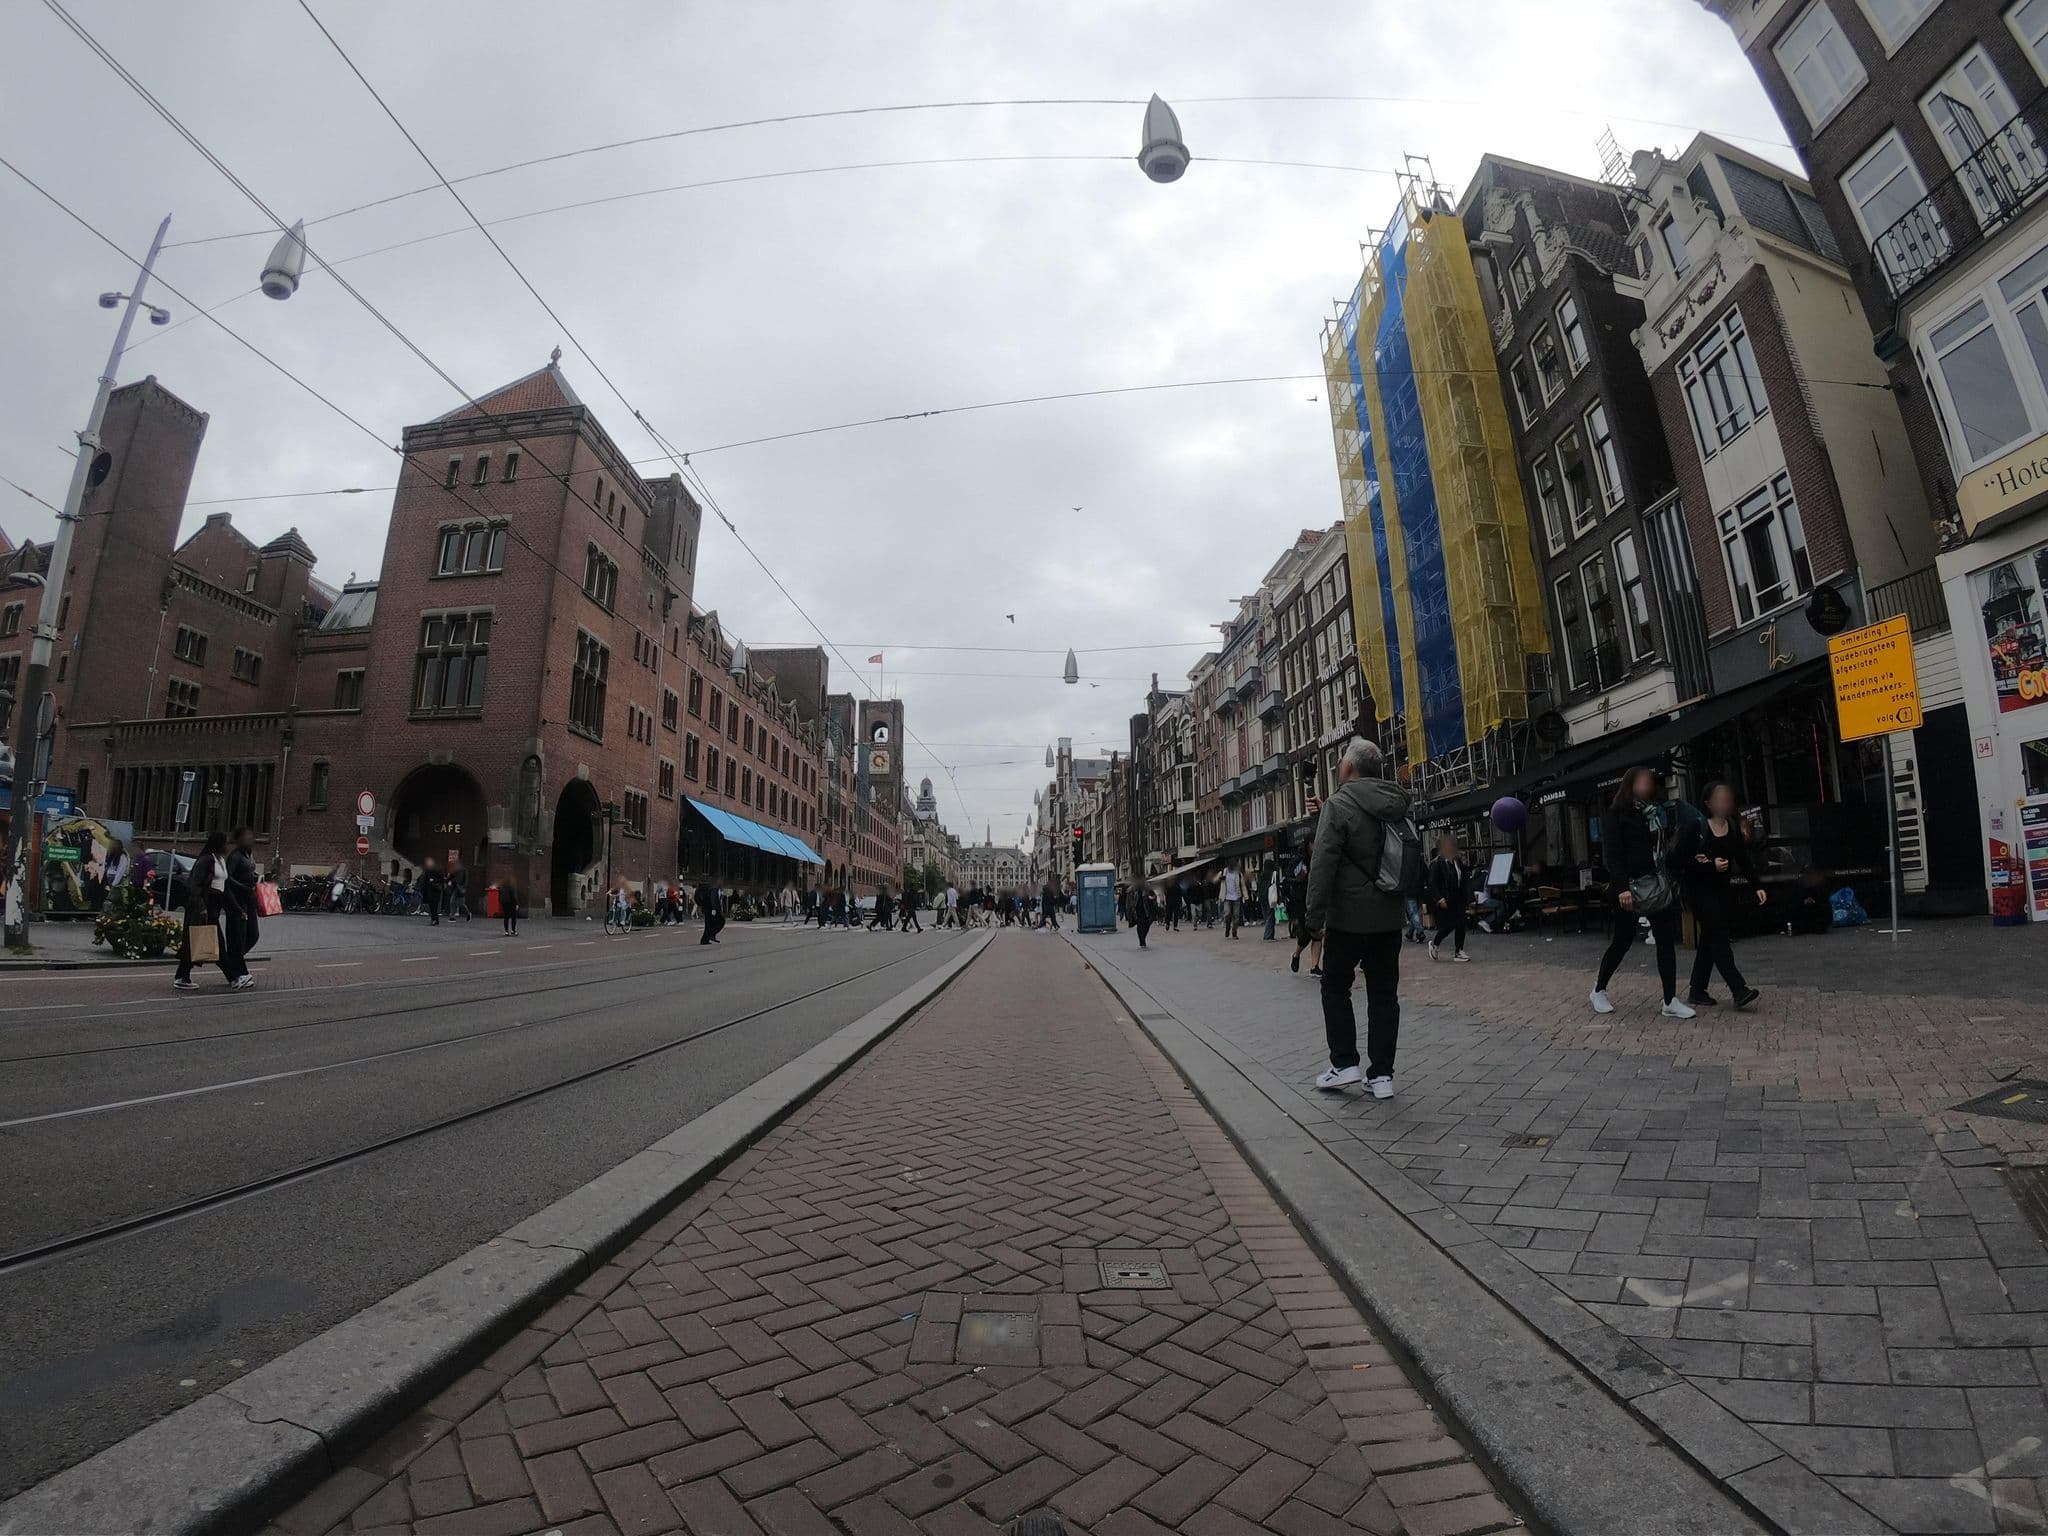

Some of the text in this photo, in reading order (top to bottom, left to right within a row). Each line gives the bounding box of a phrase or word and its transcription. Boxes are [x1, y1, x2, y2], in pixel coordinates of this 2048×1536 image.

[1841, 627, 1882, 646] omleiding
[1834, 640, 1895, 663] Oudebrugsteeg
[1836, 657, 1878, 675] afgesloten
[1838, 671, 1894, 692] omleiding via
[1840, 681, 1907, 702] Mandenmakers-
[1891, 690, 1915, 703] steeg
[1877, 712, 1894, 723] volg
[1979, 742, 1990, 753] 34
[434, 824, 461, 833] CAFE
